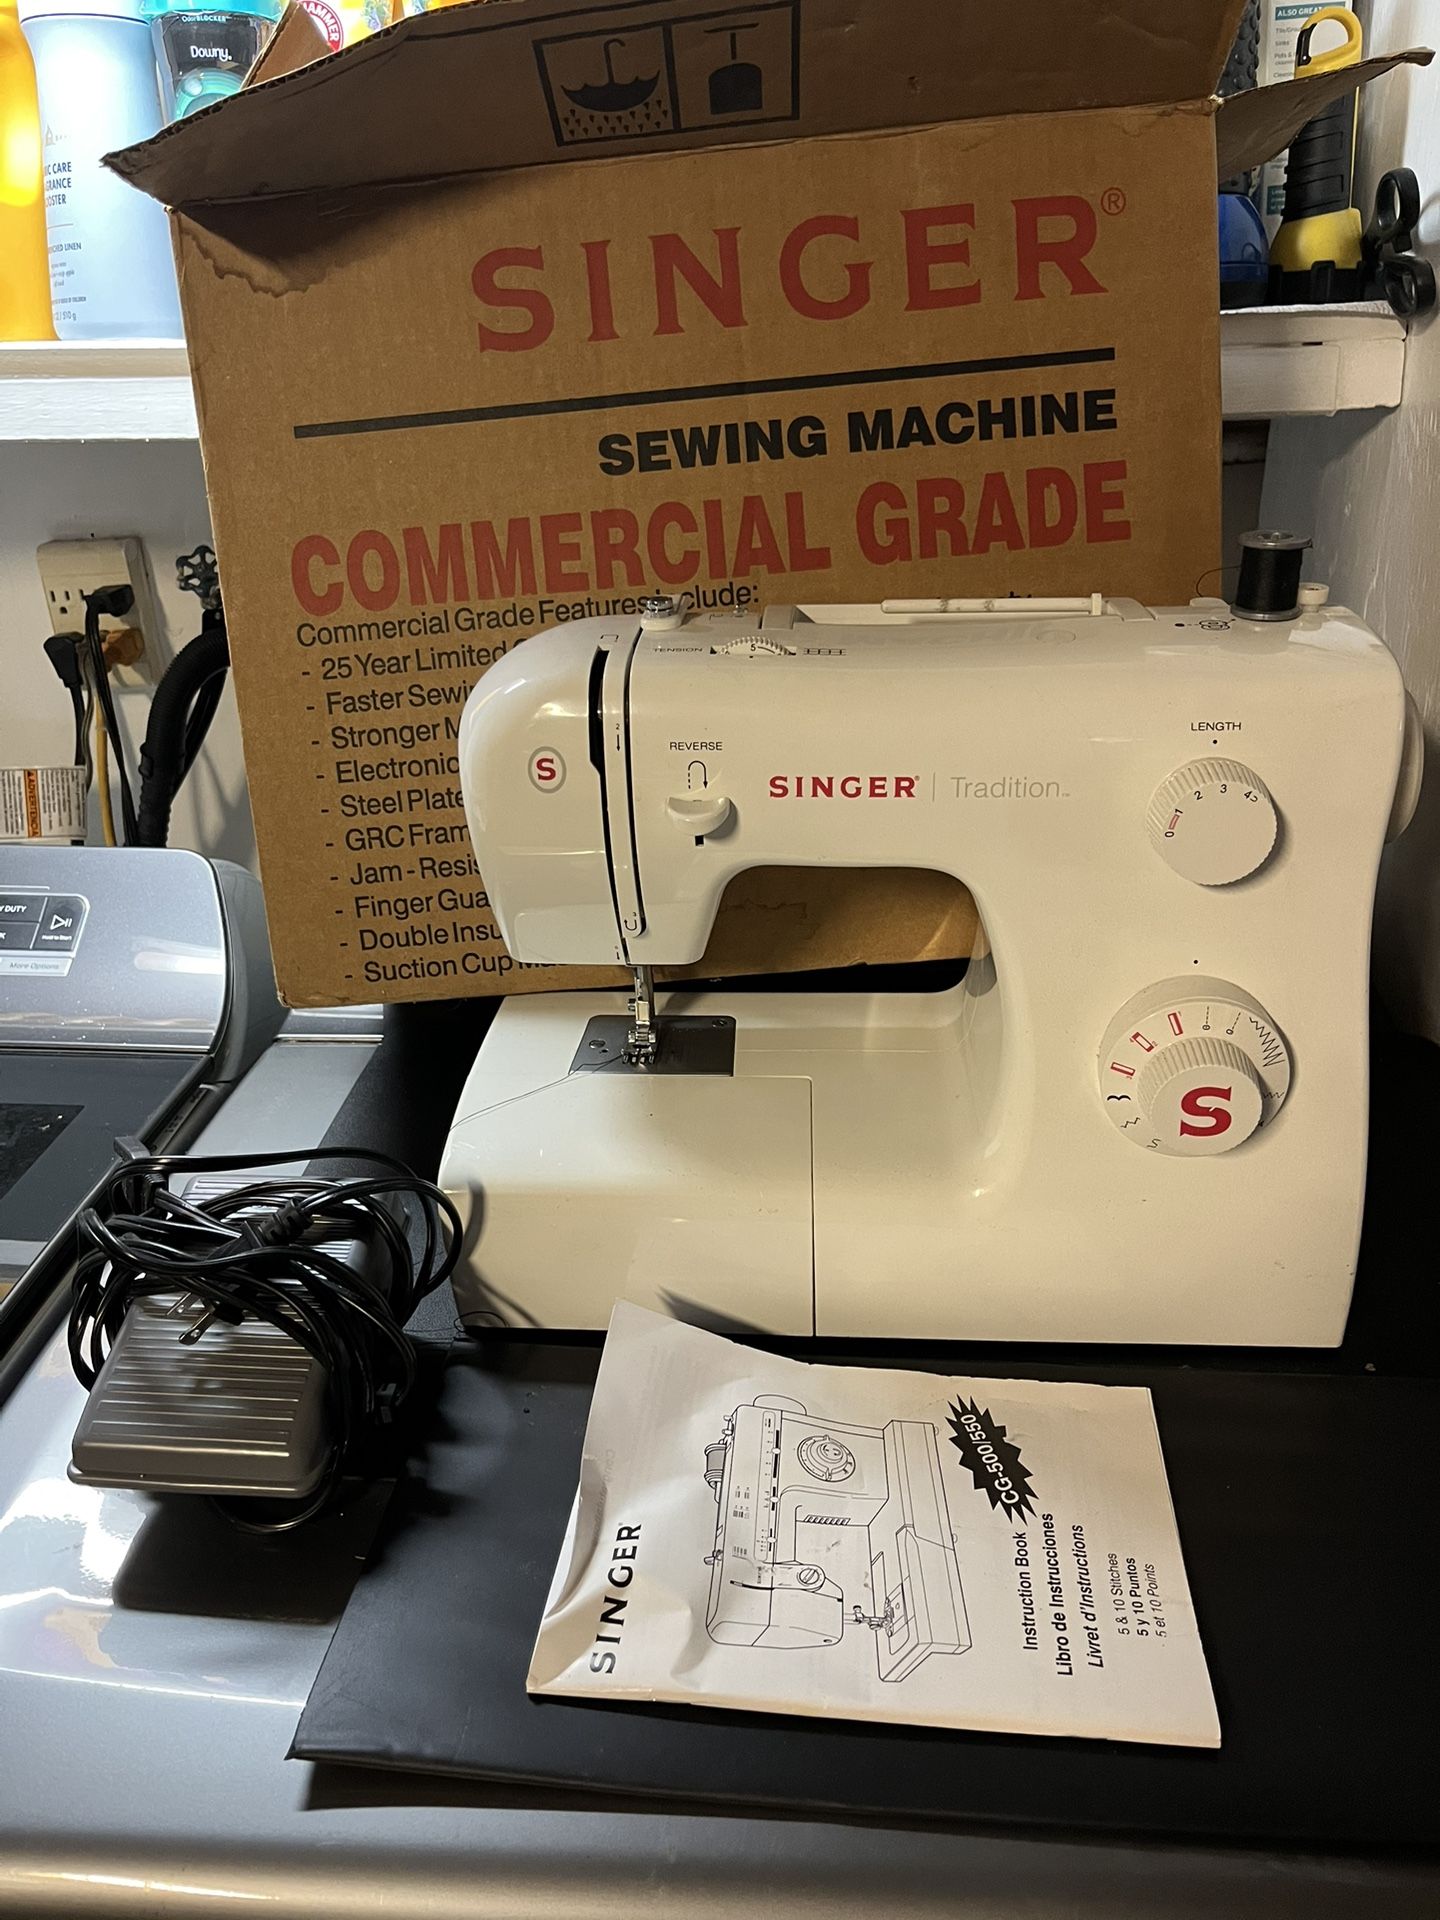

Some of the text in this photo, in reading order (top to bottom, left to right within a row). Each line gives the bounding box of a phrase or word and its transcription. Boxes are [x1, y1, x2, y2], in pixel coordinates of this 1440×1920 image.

[1277, 8, 1298, 17] ALSO
[52, 161, 72, 174] CARE
[64, 242, 82, 251] LINEN
[599, 388, 1118, 476] SEWING MACHINE
[290, 459, 1132, 618] COMMERCIAL GRADE
[296, 608, 450, 648] Commercial
[454, 603, 535, 632] Grade
[539, 594, 649, 624] Features
[321, 656, 354, 682] 25
[355, 650, 412, 678] Year
[416, 641, 507, 672] Limited
[750, 643, 757, 651] 5
[326, 680, 473, 715] Faster Sewi
[331, 719, 443, 752] Stronger
[1190, 721, 1242, 732] LENGTH
[668, 740, 723, 751] REVERSE
[340, 790, 403, 818] Steel
[1193, 790, 1204, 801] 2
[1220, 783, 1228, 794] 3
[345, 823, 470, 851] GRC Fram
[4, 904, 28, 913] DUTY
[355, 888, 491, 920] Finger Gua
[359, 920, 503, 951] Double Insu
[364, 952, 514, 983] Suction Cup
[959, 1413, 1021, 1506] CG-500/550
[1012, 1531, 1039, 1650] Instruction Book
[1042, 1513, 1073, 1676] Libro de Instrucciones
[1107, 1553, 1130, 1635] 5 & 10 Stitches
[1144, 1564, 1159, 1598] Points
[1126, 1558, 1149, 1637] 5 y 10 Puntos
[1150, 1600, 1163, 1612] 10
[1153, 1616, 1166, 1627] et
[1083, 1628, 1104, 1668] Livret
